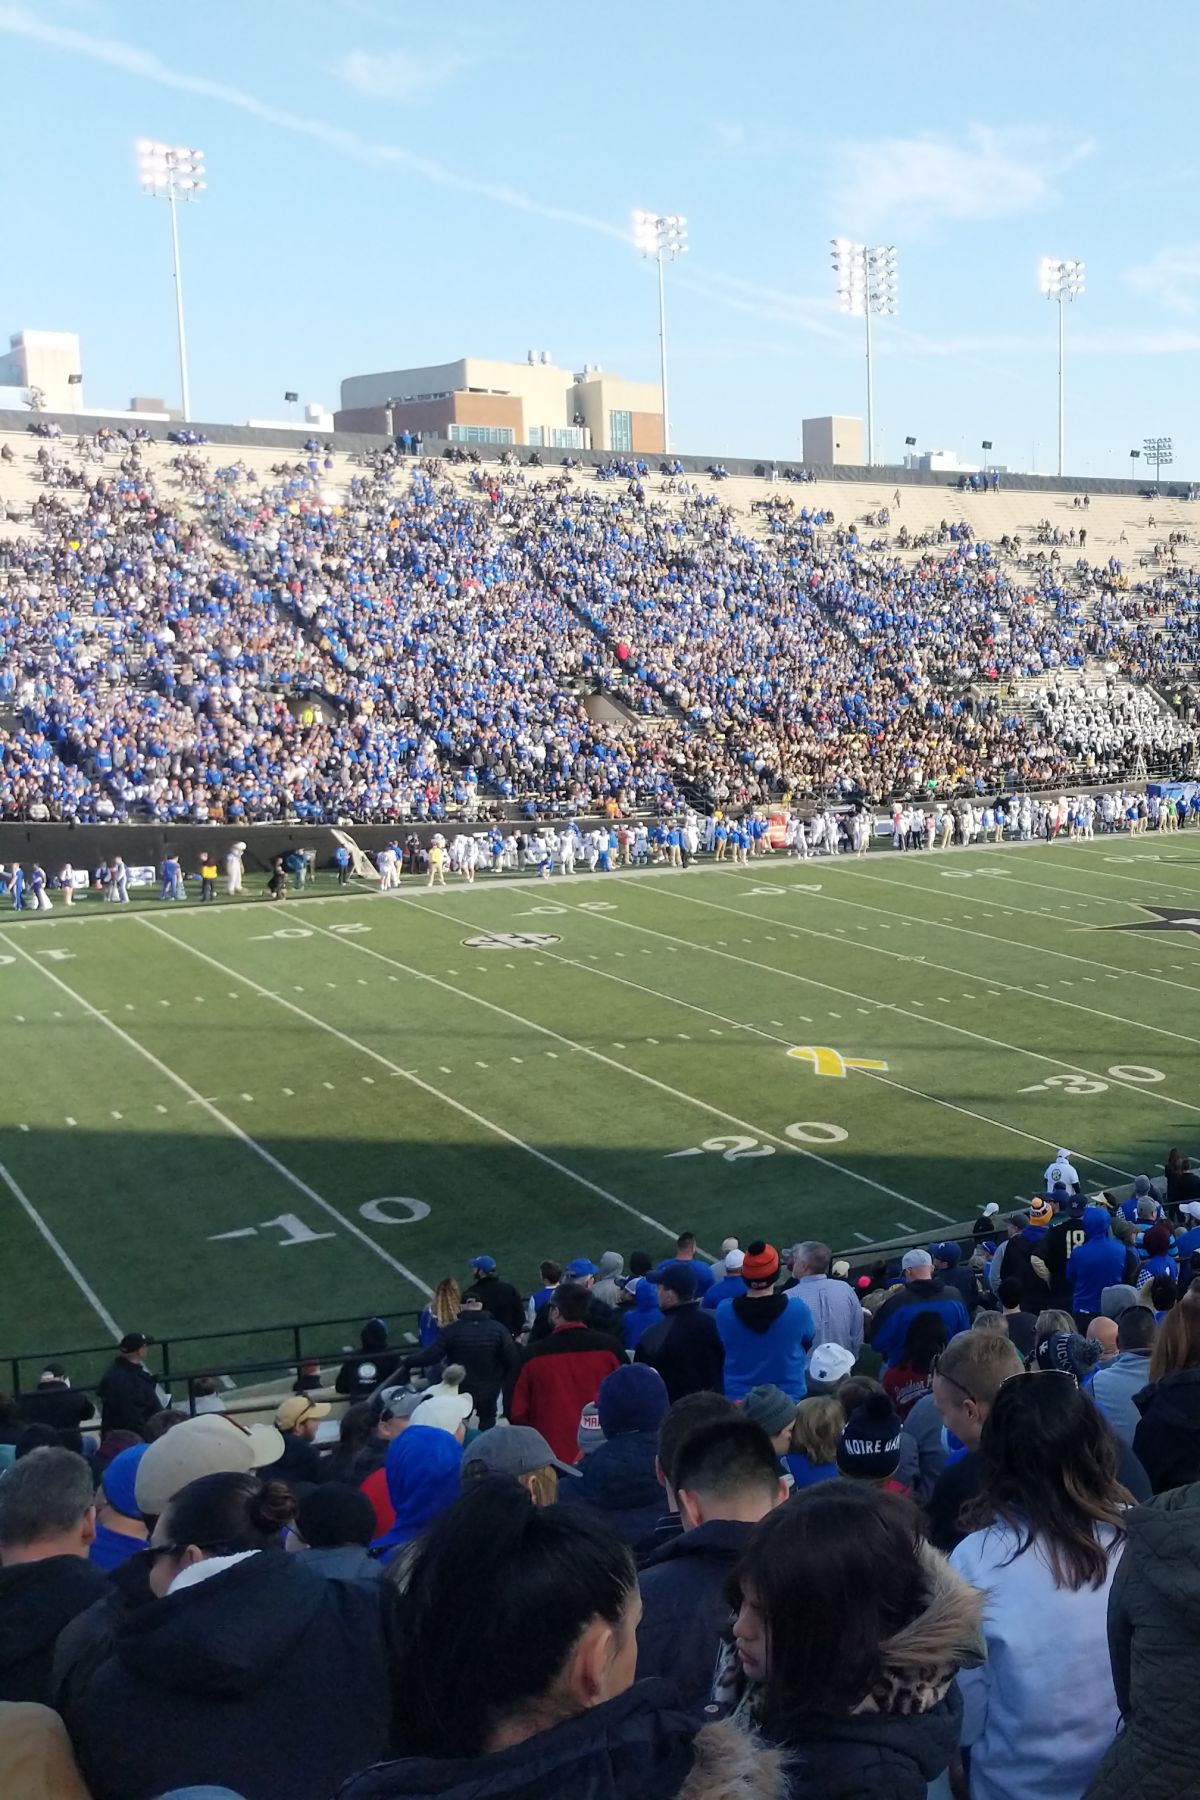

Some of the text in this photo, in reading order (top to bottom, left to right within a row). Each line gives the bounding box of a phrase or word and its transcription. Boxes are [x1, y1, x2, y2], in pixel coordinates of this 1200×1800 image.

[1043, 1065, 1167, 1095] 30
[702, 1121, 849, 1162] 20
[259, 1196, 432, 1246] 10
[1065, 1230, 1085, 1259] 18
[844, 1438, 882, 1456] NOTRE
